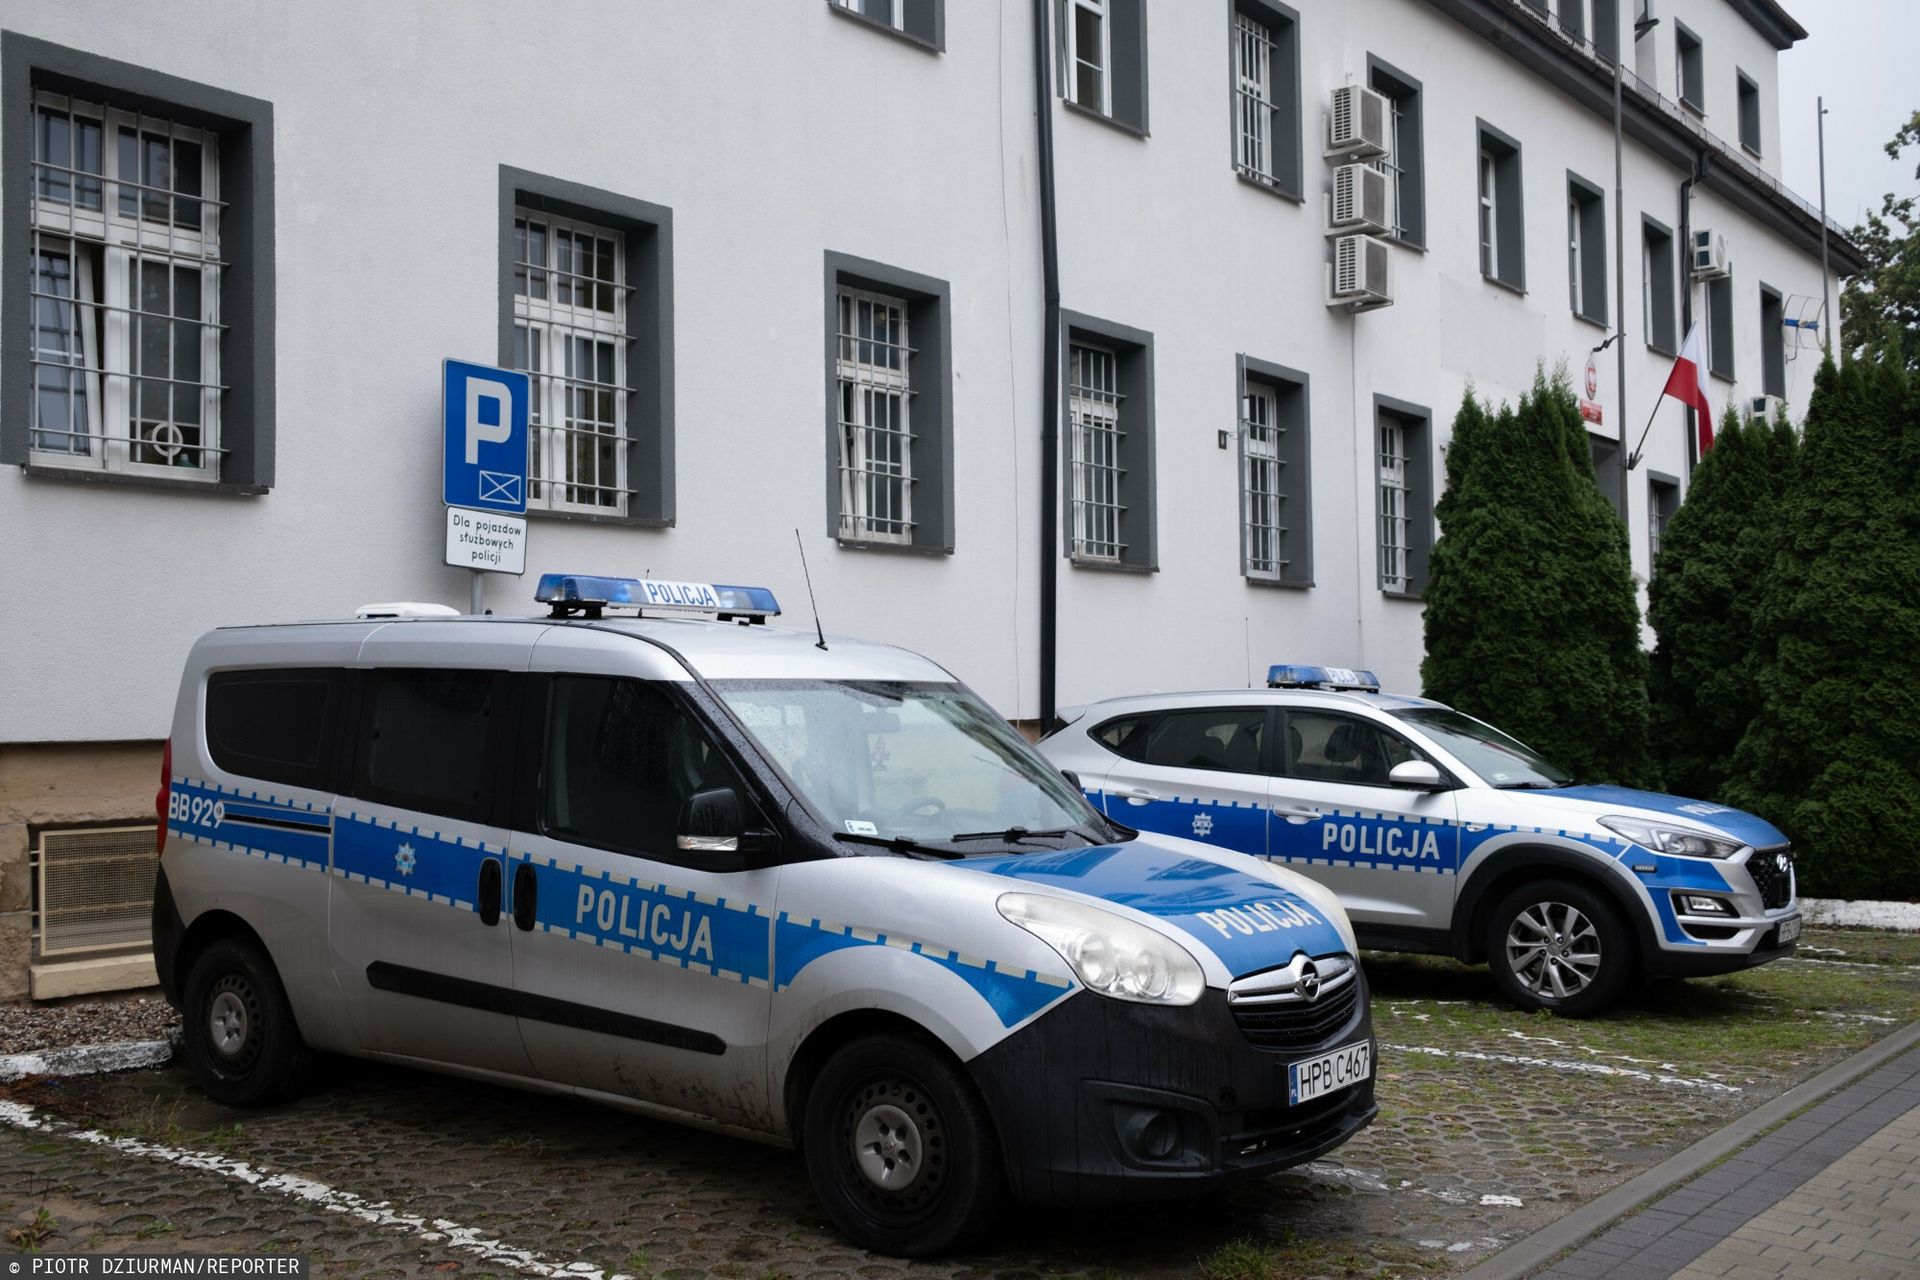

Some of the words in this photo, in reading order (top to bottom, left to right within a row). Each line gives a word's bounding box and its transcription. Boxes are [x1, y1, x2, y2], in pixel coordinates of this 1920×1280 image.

[465, 375, 512, 464] P
[453, 514, 470, 527] Dla
[459, 531, 514, 549] służbowych
[471, 550, 501, 565] policji
[646, 582, 716, 607] POLICJA
[1322, 822, 1440, 860] POLICJA
[576, 883, 714, 961] POLICJA
[1195, 900, 1322, 939] POLICJA
